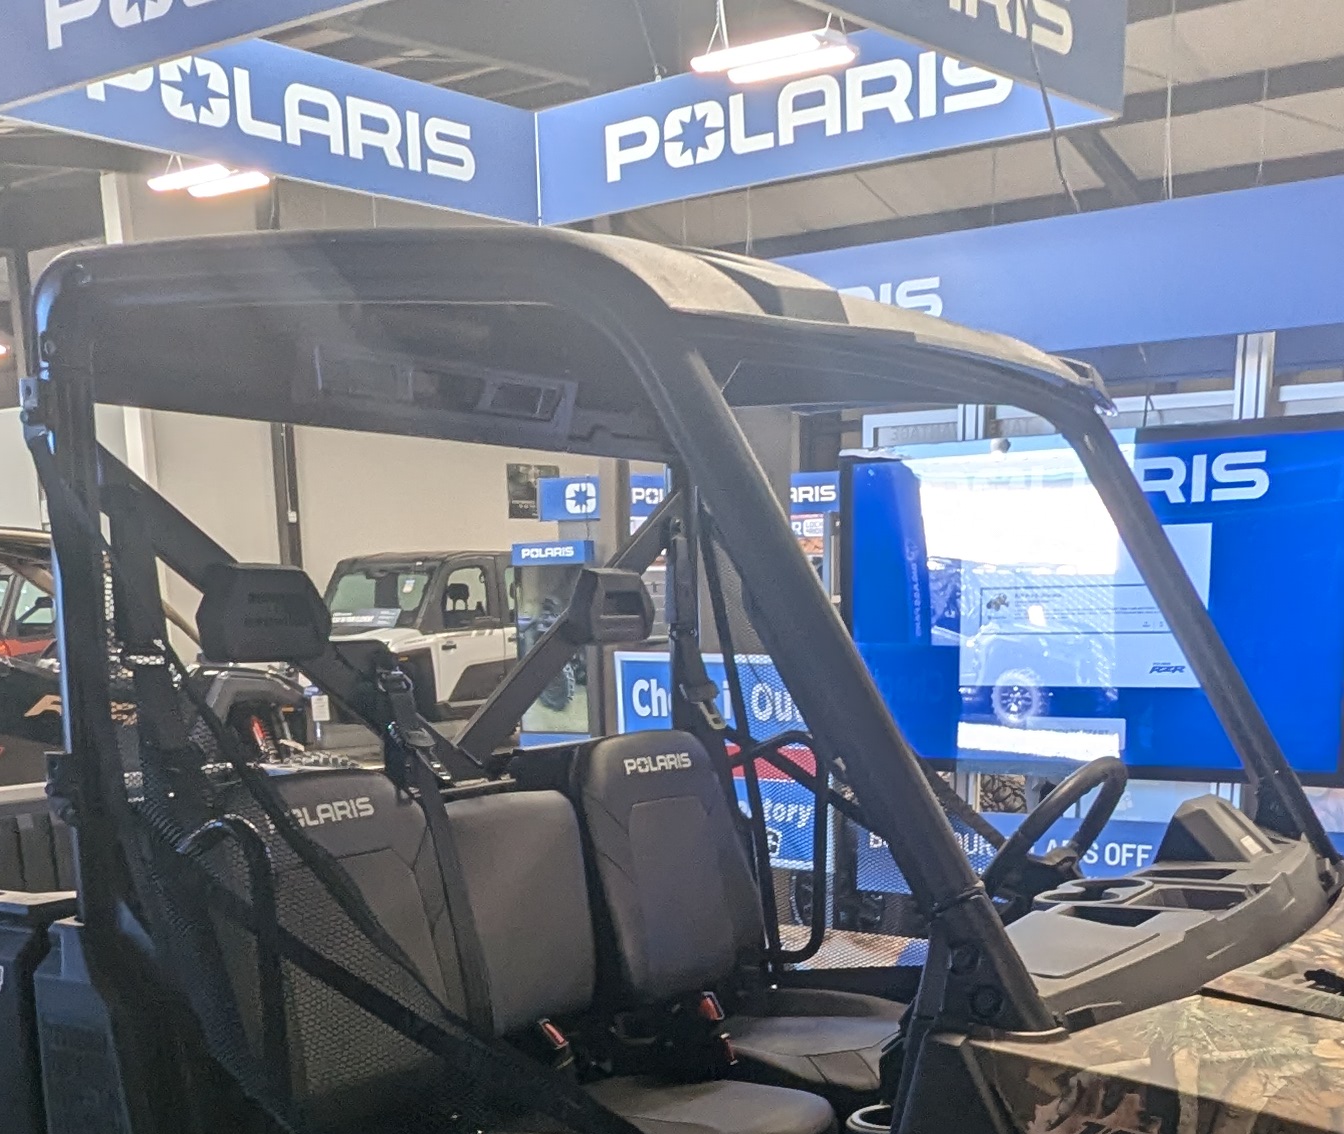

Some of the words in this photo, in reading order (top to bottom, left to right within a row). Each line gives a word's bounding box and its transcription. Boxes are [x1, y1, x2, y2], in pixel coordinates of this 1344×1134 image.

[605, 51, 1013, 183] POLARIS
[521, 546, 575, 559] POLARIS
[623, 752, 693, 775] POLARIS
[1105, 842, 1153, 867] OFF
